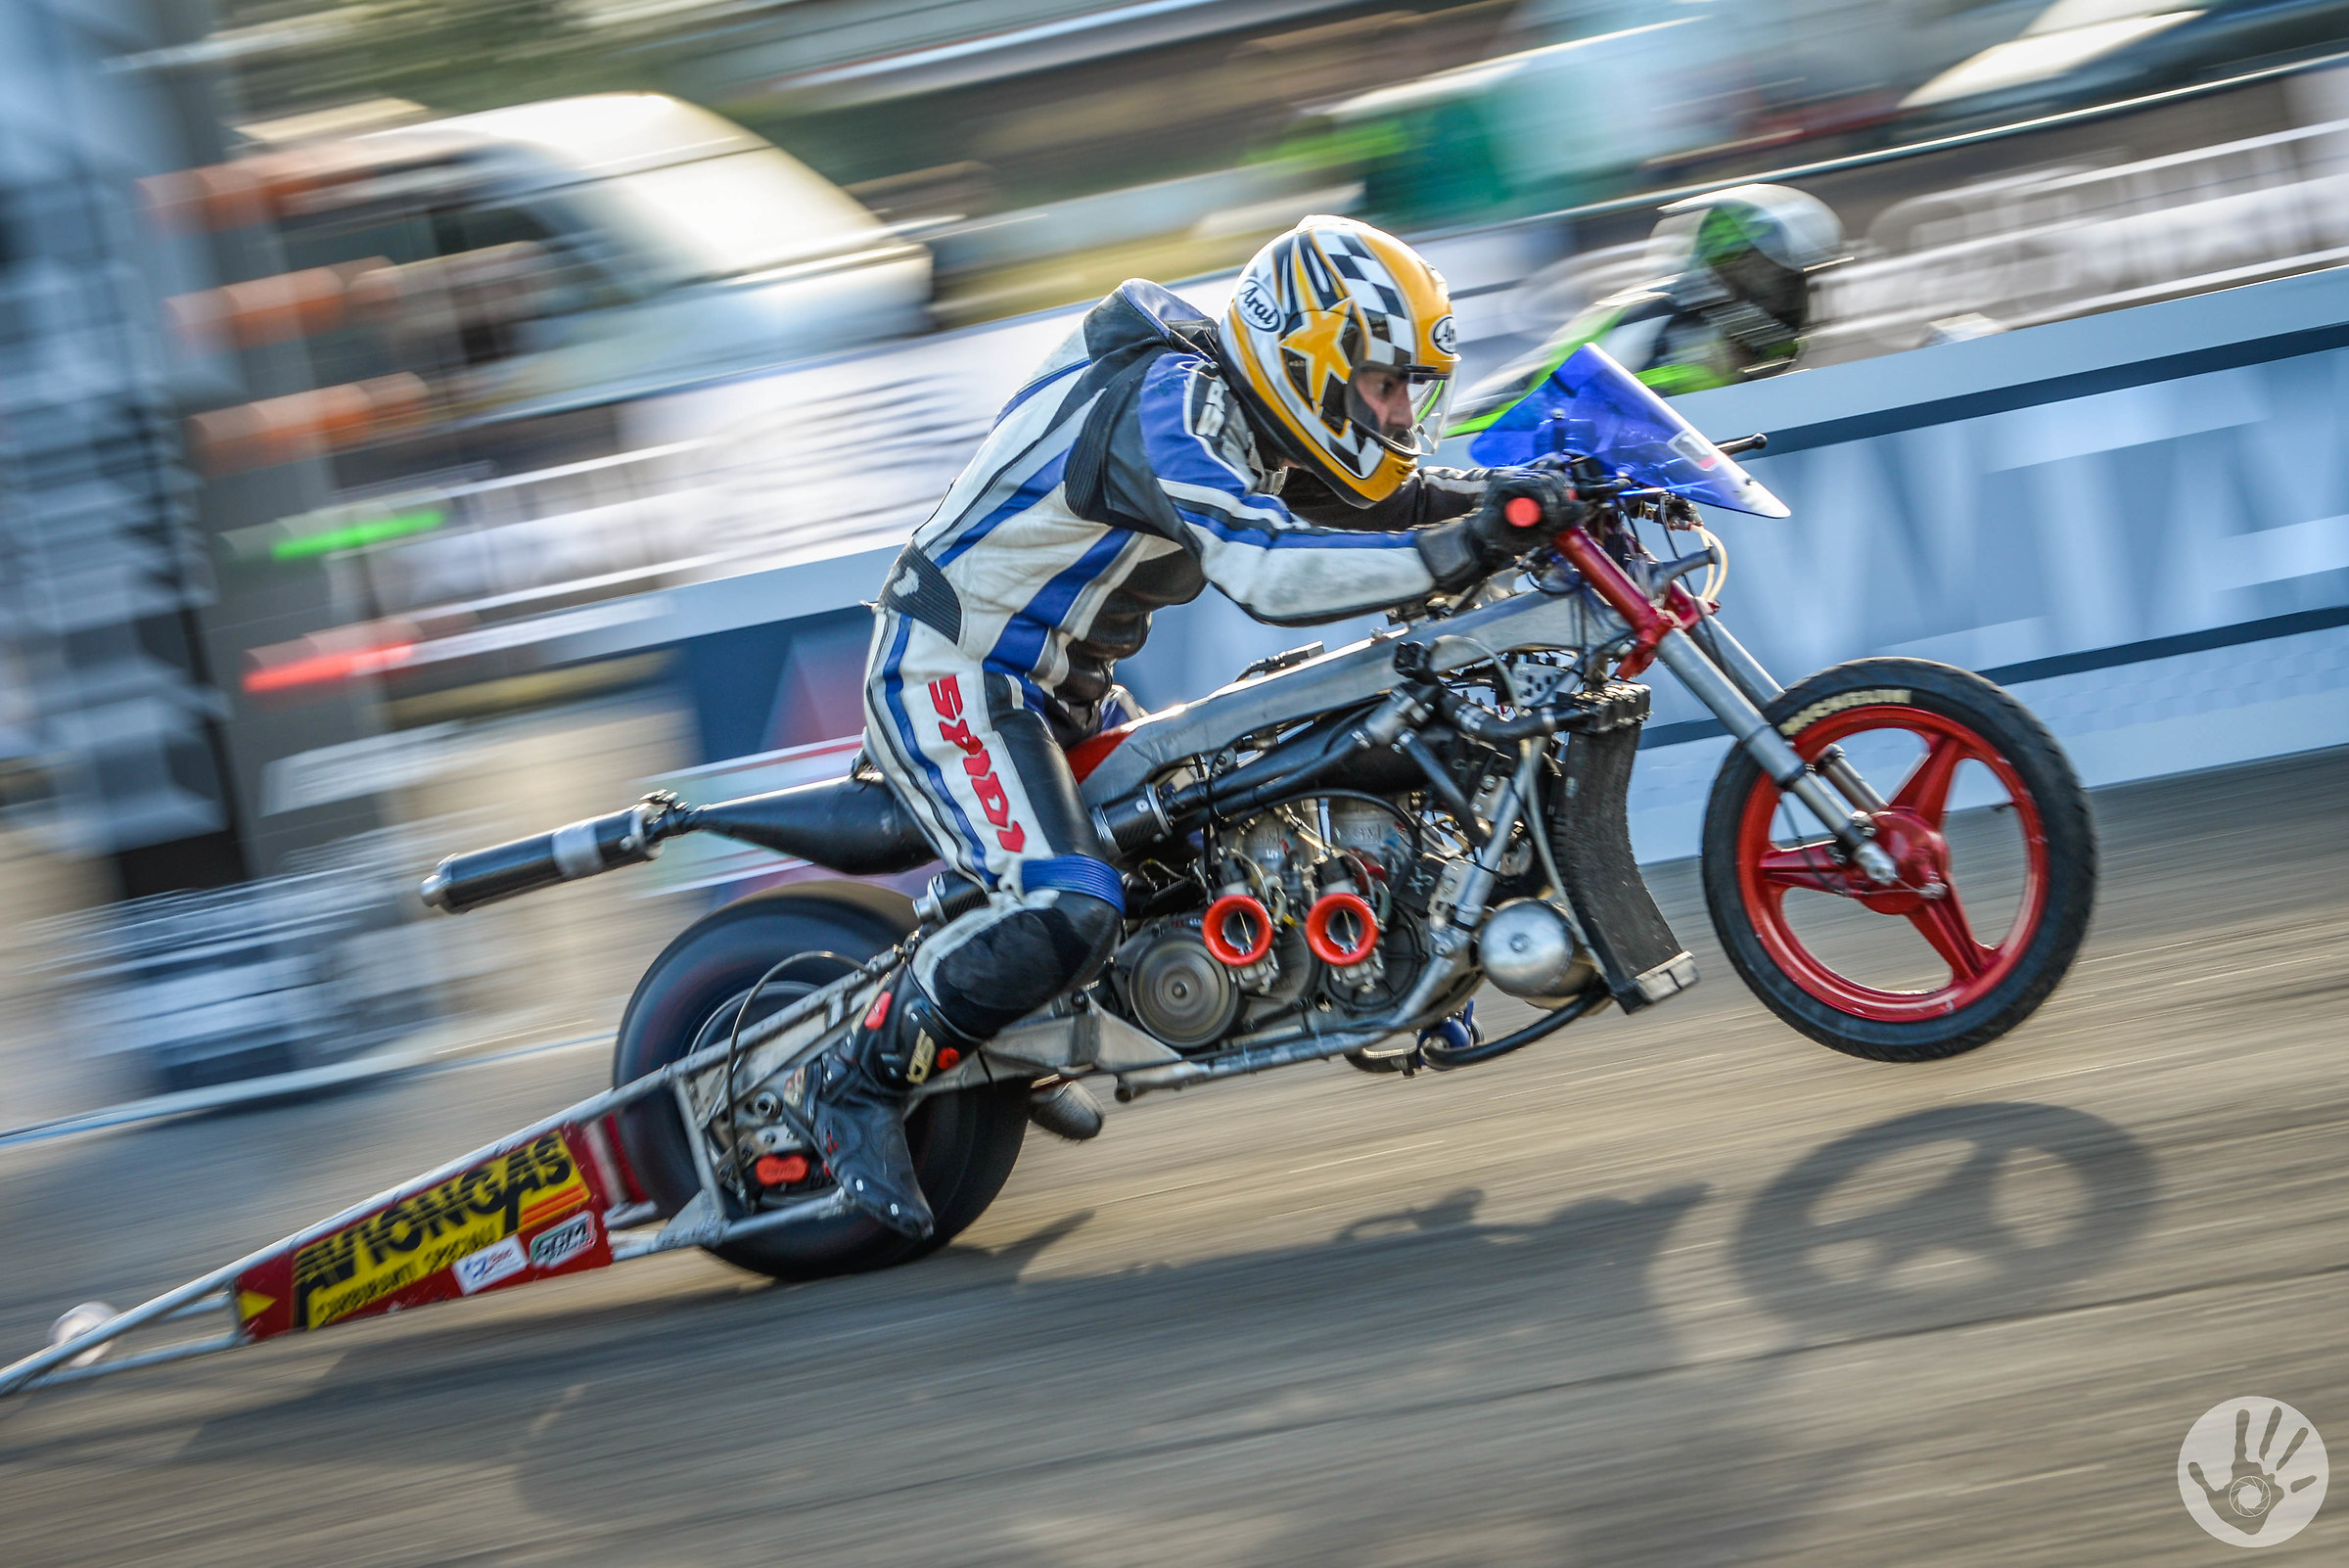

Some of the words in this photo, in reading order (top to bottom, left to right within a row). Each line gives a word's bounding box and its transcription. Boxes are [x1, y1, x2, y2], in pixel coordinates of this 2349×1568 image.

[1239, 286, 1277, 324] Arai
[928, 674, 1026, 853] SPIDI
[295, 1132, 572, 1328] AVIONGAS
